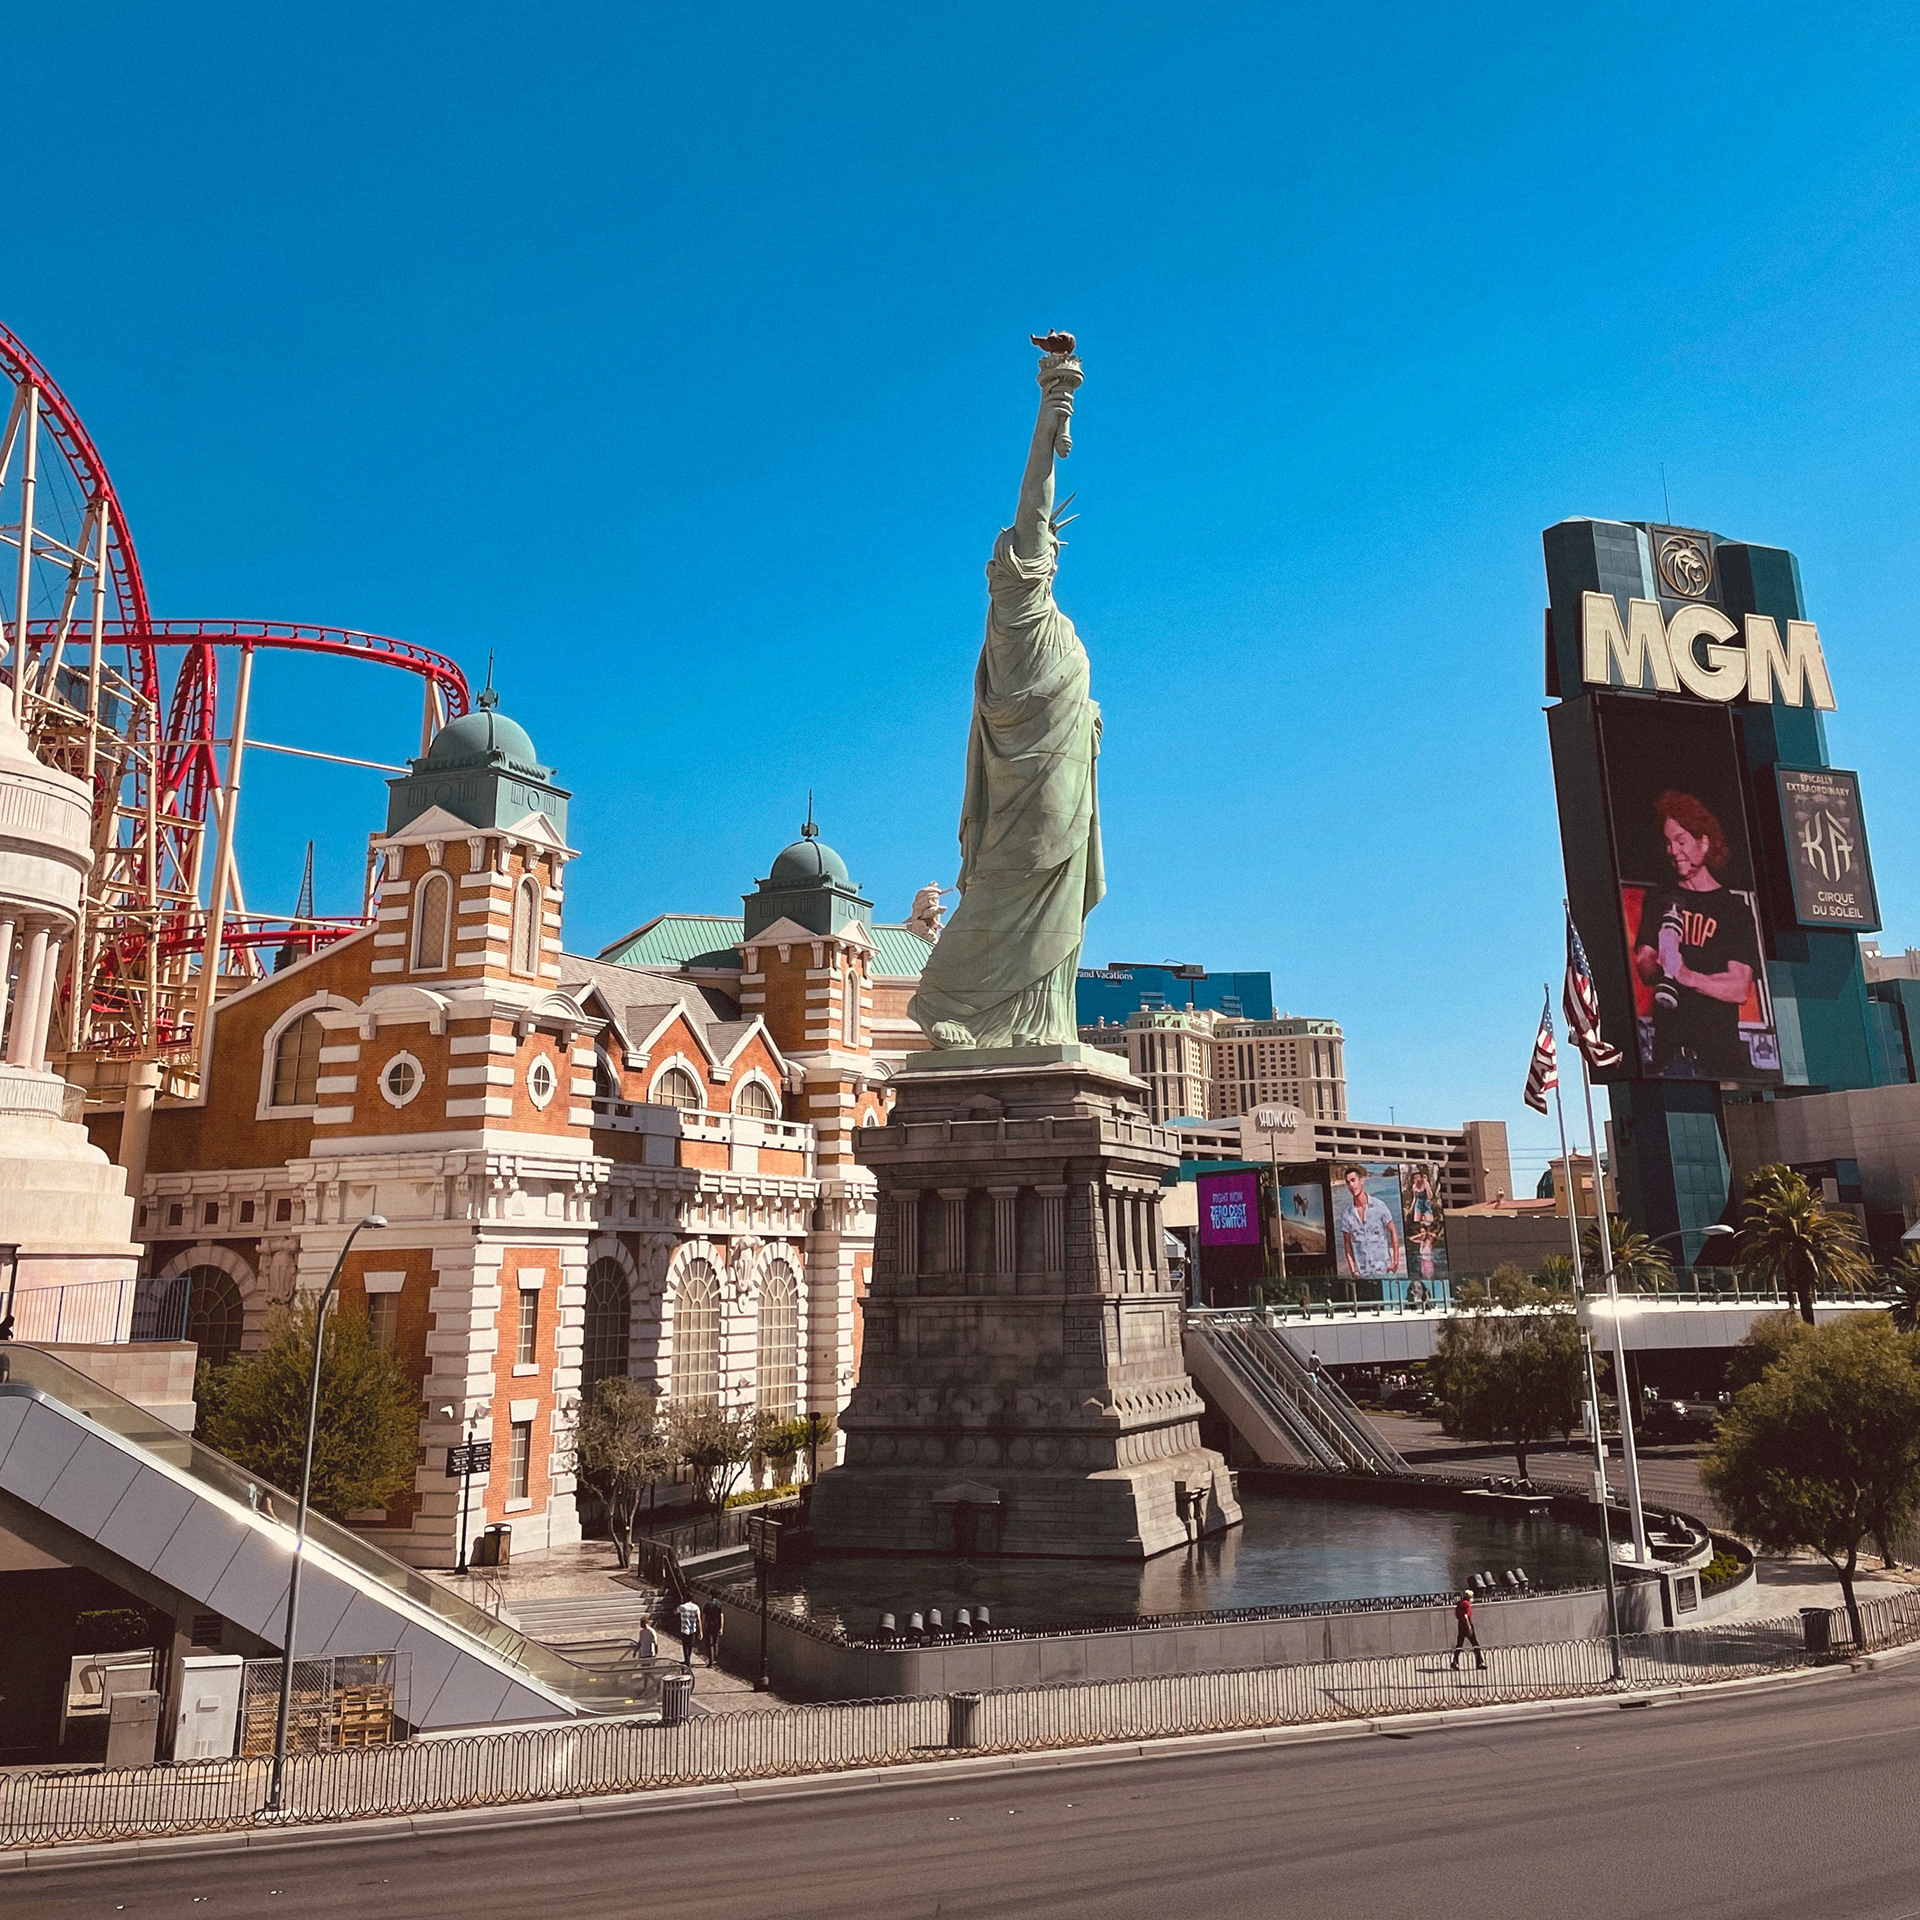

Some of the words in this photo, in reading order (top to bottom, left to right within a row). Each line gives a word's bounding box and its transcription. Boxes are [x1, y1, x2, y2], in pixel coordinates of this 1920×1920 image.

[1583, 590, 1838, 712] MGM
[1800, 774, 1833, 784] EPICALLY
[1786, 782, 1850, 797] EXTRAORDINARY
[1817, 891, 1855, 906] CIRQUE
[1812, 905, 1827, 916] DU
[1829, 906, 1864, 919] SOLEIL
[1096, 970, 1133, 980] Vacations
[1259, 1110, 1298, 1128] SHOWCASE
[1213, 1193, 1228, 1203] RIGHT
[1230, 1192, 1243, 1202] NOW
[1210, 1205, 1228, 1217] ZERO
[1229, 1203, 1246, 1216] COST
[1211, 1215, 1220, 1229] TO
[1221, 1216, 1247, 1229] SWITCH
